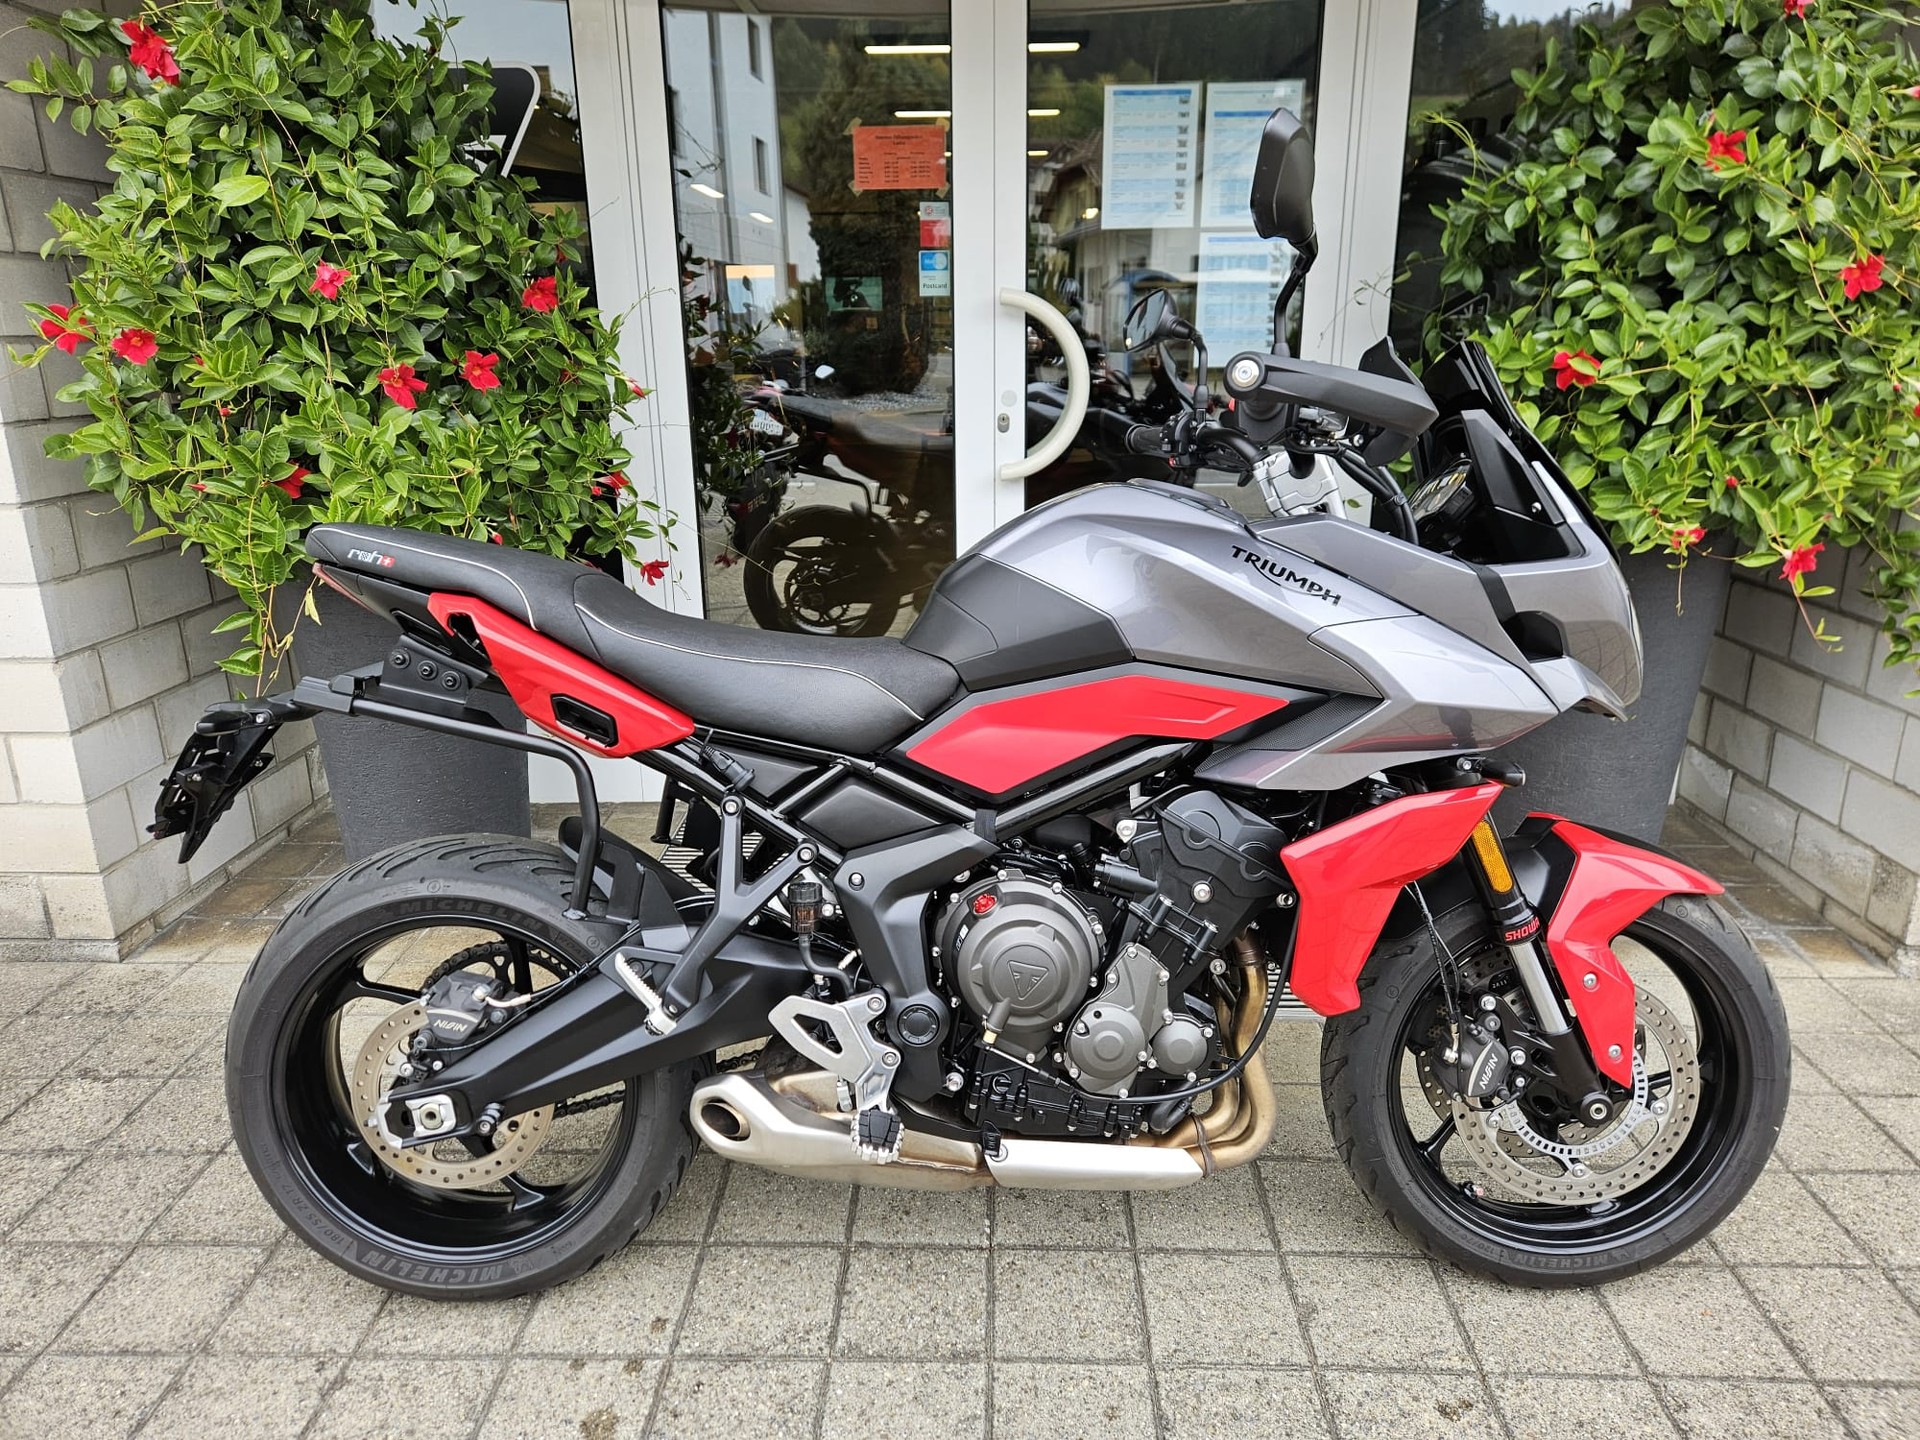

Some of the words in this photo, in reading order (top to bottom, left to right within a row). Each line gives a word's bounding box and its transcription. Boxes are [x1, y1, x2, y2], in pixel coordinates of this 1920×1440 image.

[1232, 545, 1341, 606] TRIUMPH
[401, 900, 545, 932] MICHELIN
[1505, 916, 1540, 941] SHOWA
[1479, 1053, 1499, 1090] NISSIN
[292, 1197, 308, 1211] ZR
[306, 1213, 345, 1245] 180/55
[362, 1250, 503, 1283] MICHELIN
[1512, 1254, 1607, 1269] MICHELIN
